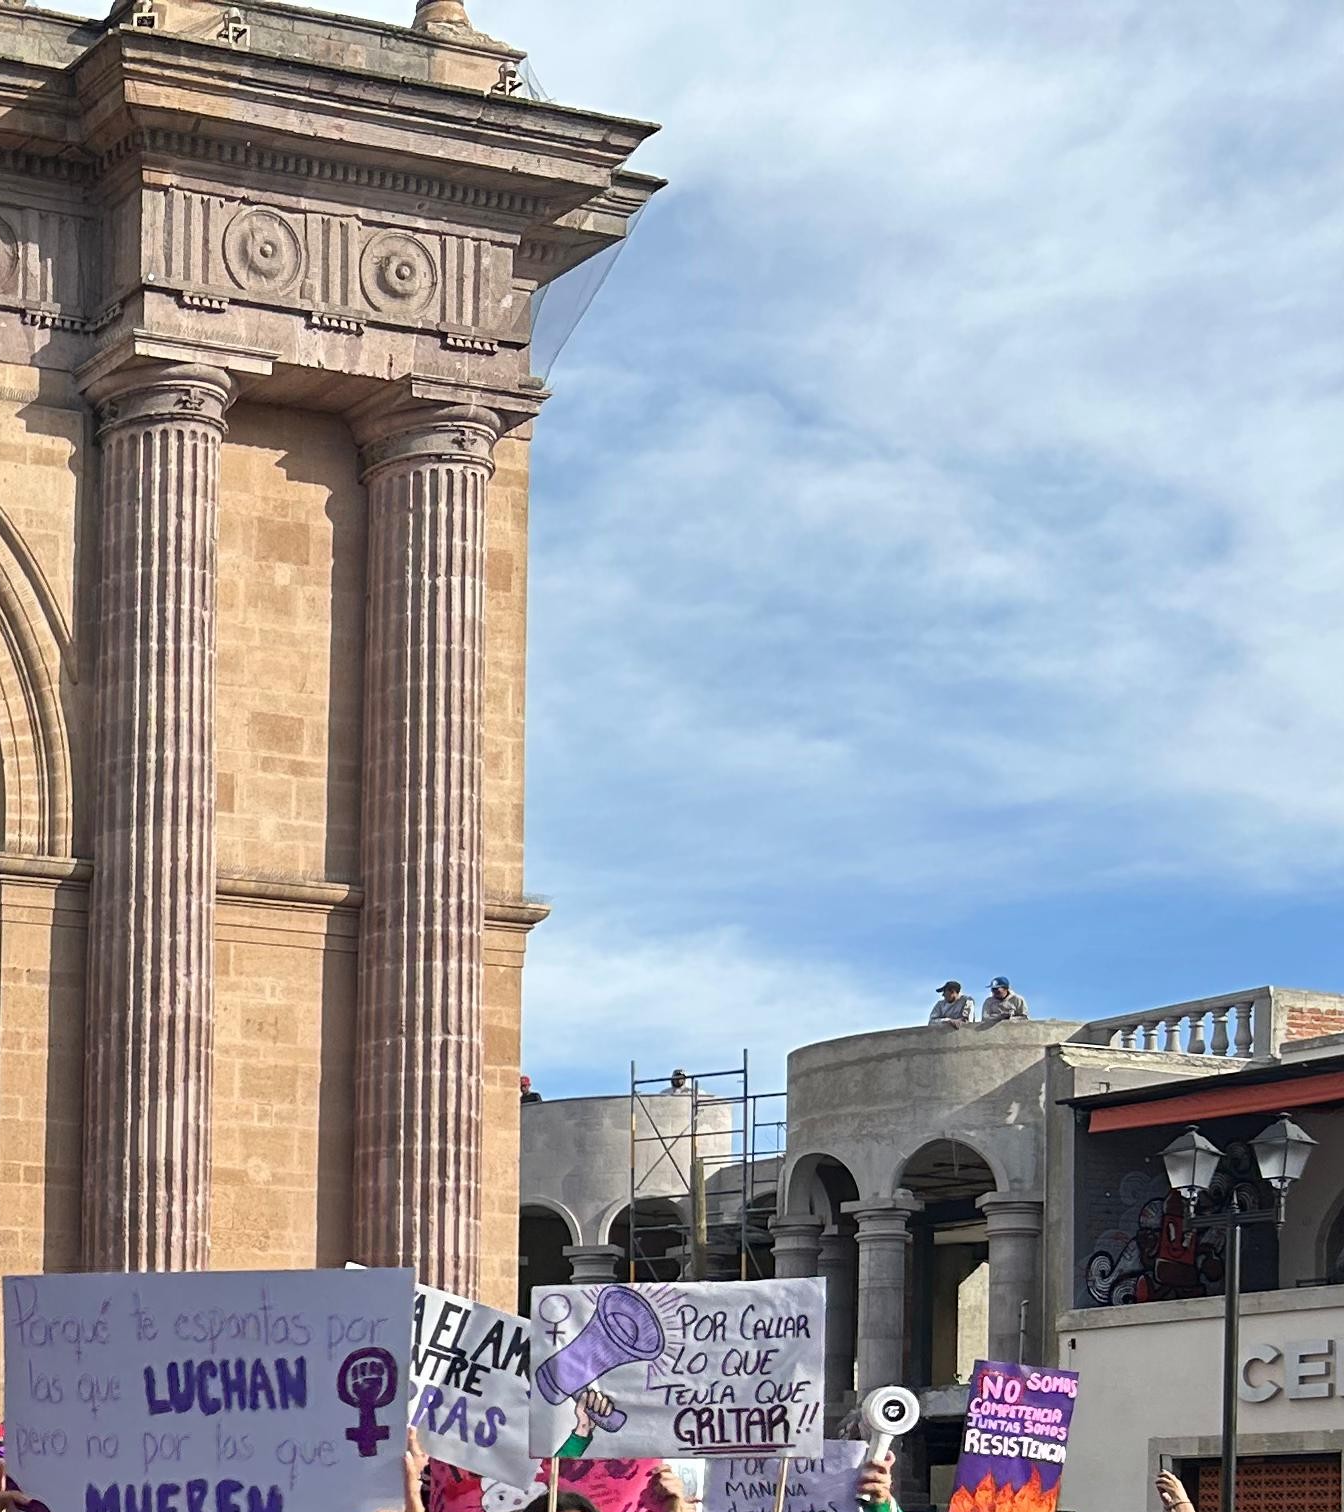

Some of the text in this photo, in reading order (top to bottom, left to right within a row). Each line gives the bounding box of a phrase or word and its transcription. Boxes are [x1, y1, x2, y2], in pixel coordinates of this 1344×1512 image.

[676, 1303, 728, 1342] POR
[470, 1319, 531, 1378] AM
[671, 1346, 779, 1377] LO QUE
[144, 1356, 307, 1416] LUCHAN
[412, 1343, 491, 1398] NTRE
[1238, 1339, 1344, 1404] CE
[755, 1379, 812, 1404] QUE
[982, 1372, 1079, 1404] NO SOMOS
[966, 1412, 1067, 1441] JUNTAS SOMOS
[969, 1397, 1063, 1424] COMPETENCIA
[86, 1434, 120, 1459] no
[964, 1428, 1067, 1464] RESISTENCIA
